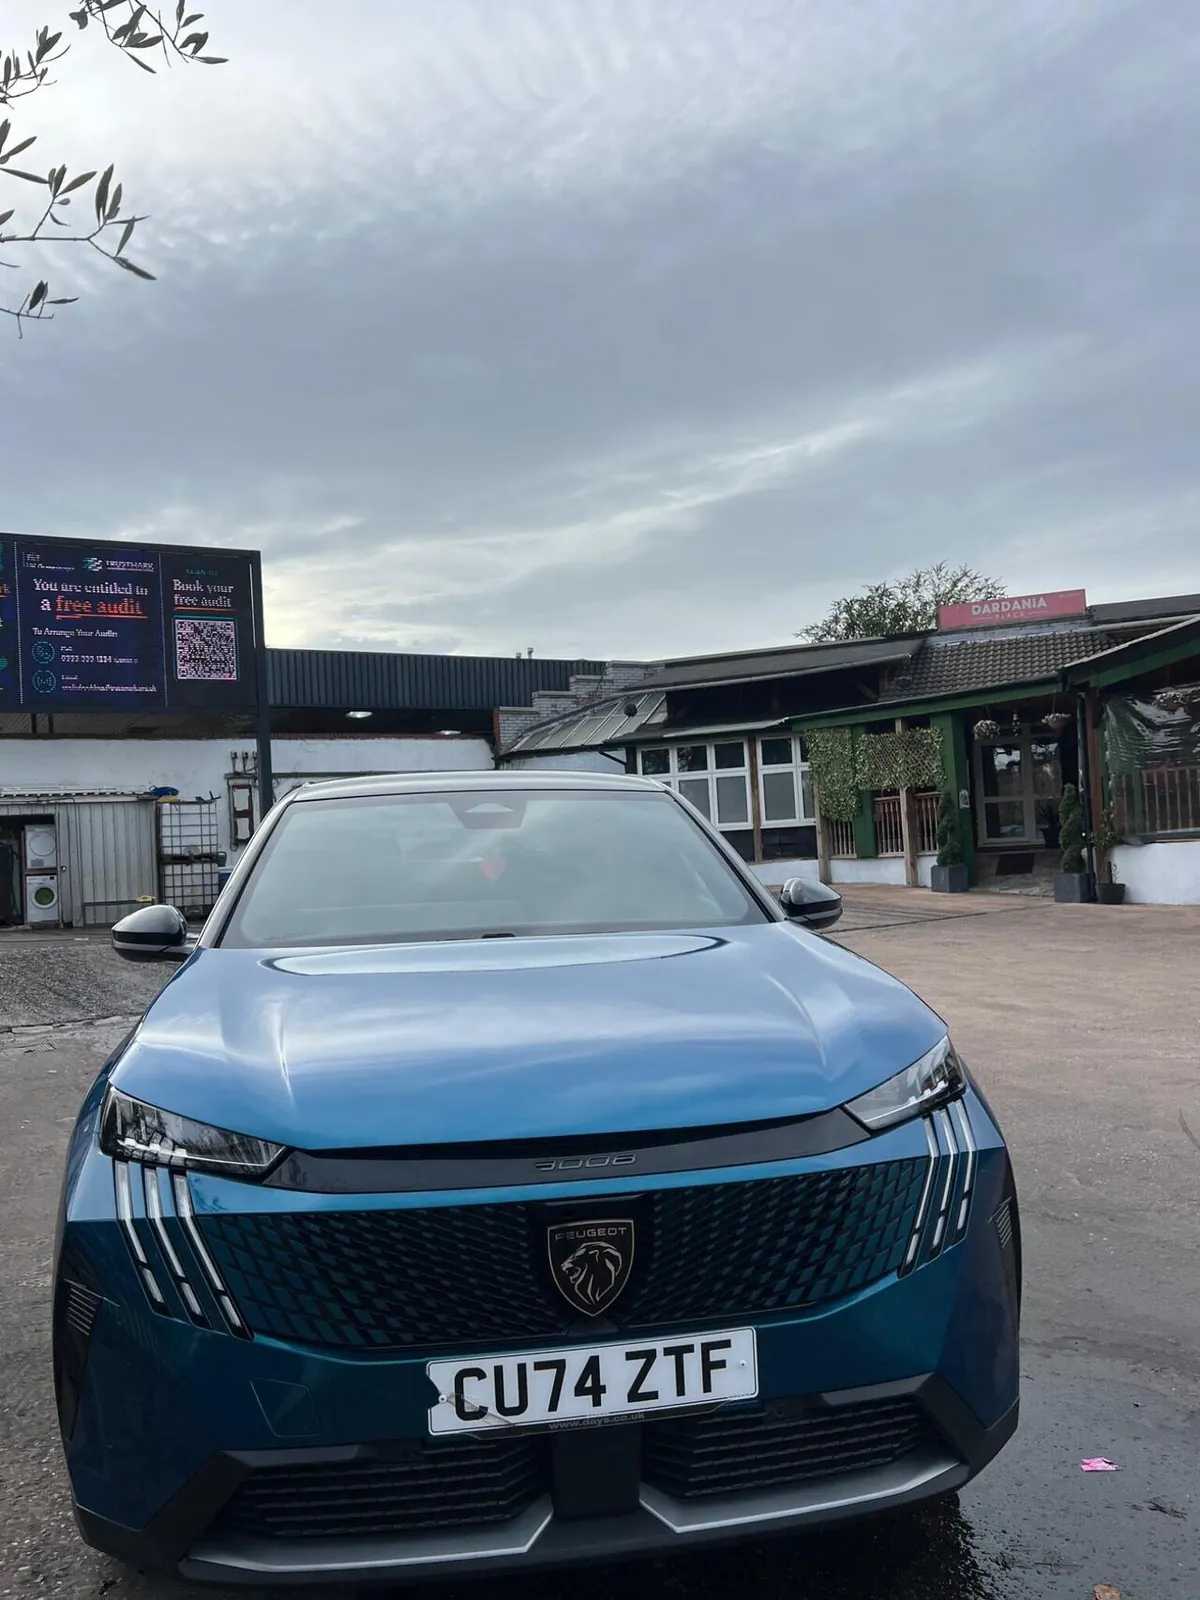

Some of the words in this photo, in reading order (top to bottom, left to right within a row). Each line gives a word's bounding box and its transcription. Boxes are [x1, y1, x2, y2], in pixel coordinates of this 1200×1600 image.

[33, 578, 58, 591] You
[61, 583, 82, 593] are
[85, 582, 133, 595] entitled
[172, 579, 204, 592] Book
[206, 585, 234, 594] your
[40, 598, 52, 611] a
[56, 595, 92, 612] free
[96, 598, 143, 614] audit
[173, 594, 198, 606] free
[201, 596, 232, 607] audit
[971, 597, 1047, 616] DARDANIA
[995, 612, 1024, 620] PLACE
[534, 1153, 637, 1172] 3008
[554, 1226, 628, 1241] PEUGEOT
[453, 1354, 607, 1422] CU74
[624, 1339, 732, 1404] ZTF
[548, 1412, 646, 1431] www.days.co.uk
